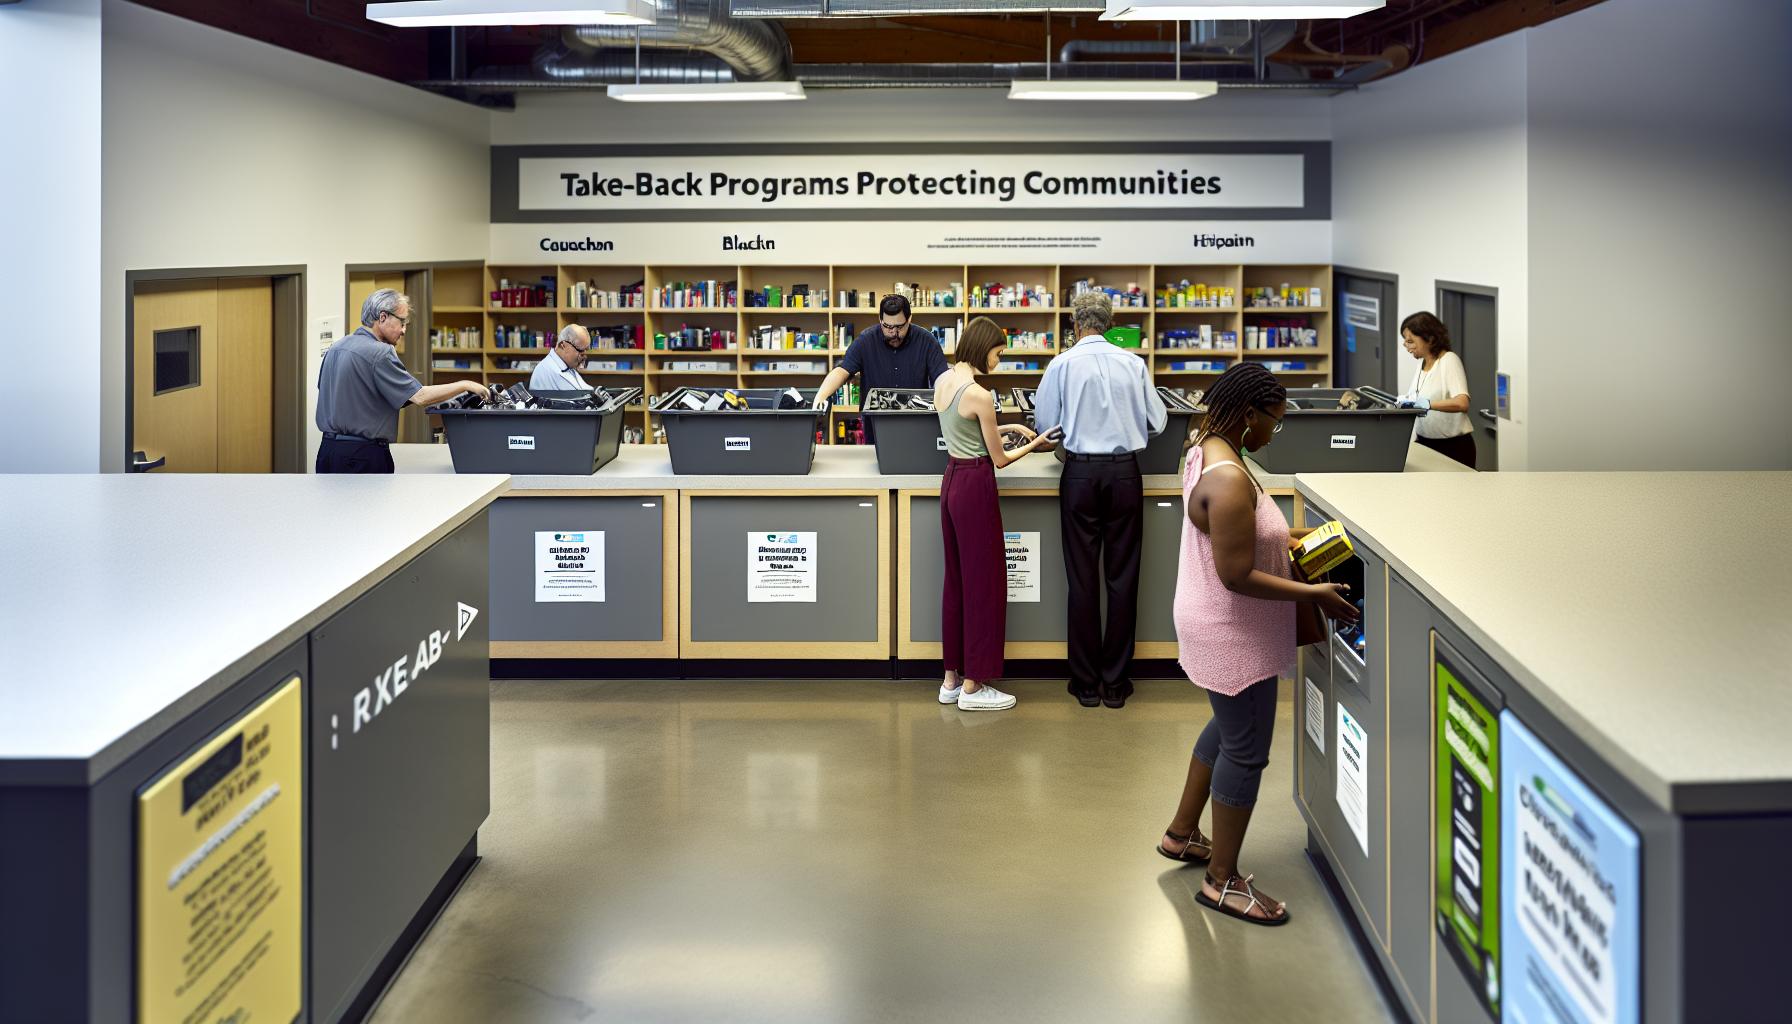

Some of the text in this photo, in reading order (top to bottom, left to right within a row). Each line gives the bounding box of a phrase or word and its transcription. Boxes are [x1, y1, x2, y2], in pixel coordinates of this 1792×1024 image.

[560, 168, 1222, 203] Take-Back Programs Protecting Communities
